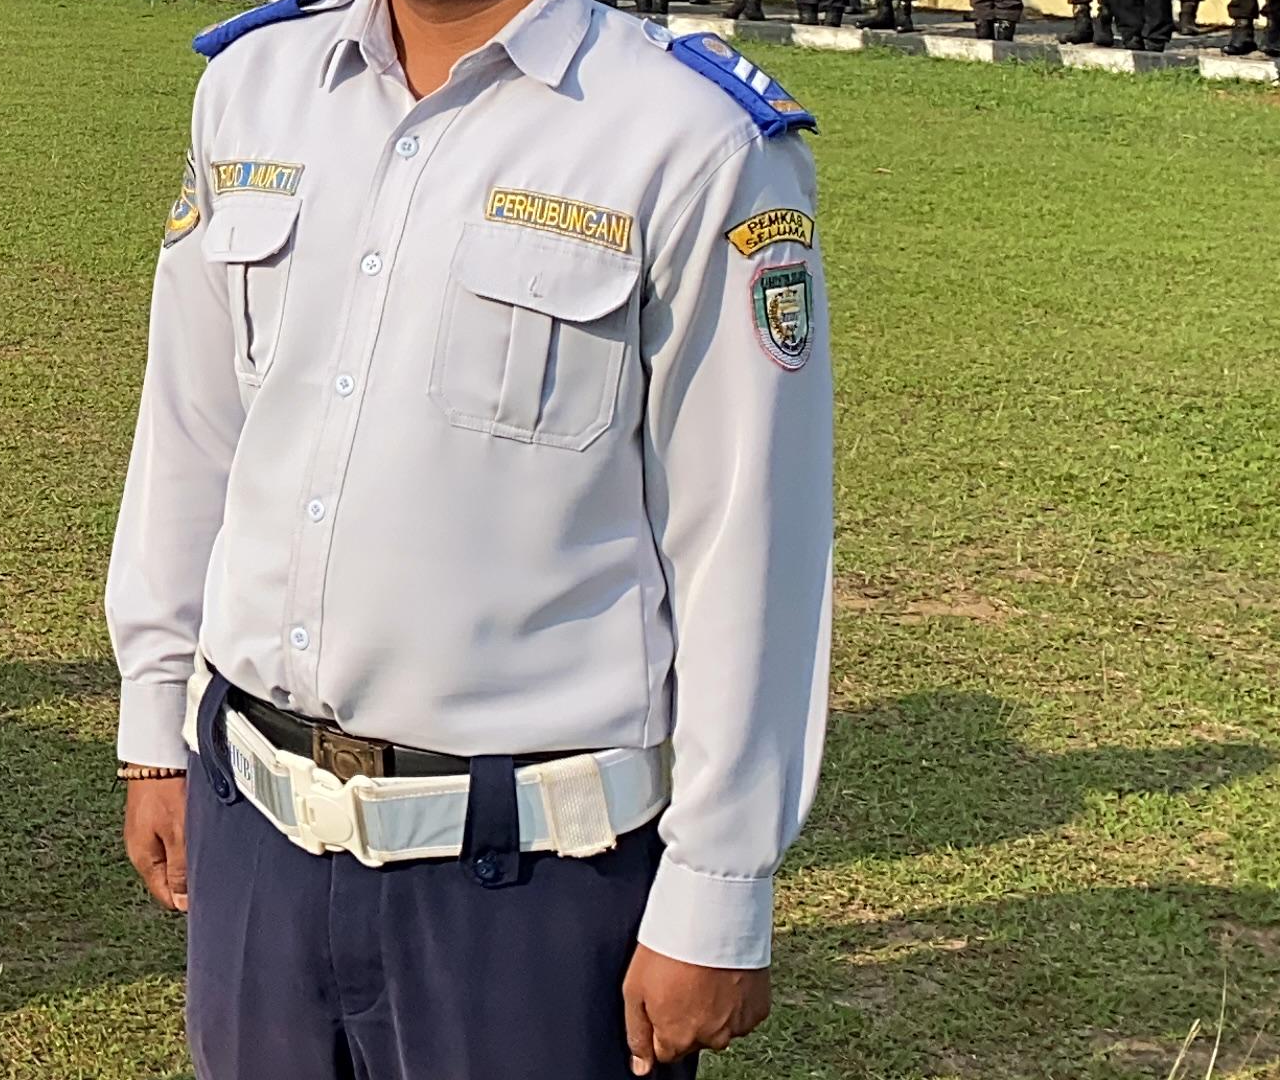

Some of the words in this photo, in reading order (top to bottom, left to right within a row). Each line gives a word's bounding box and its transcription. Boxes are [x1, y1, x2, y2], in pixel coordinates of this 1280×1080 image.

[246, 163, 296, 190] MUKTI
[492, 192, 625, 245] PERHUBUNGAN
[746, 211, 804, 235] PEMKAB
[745, 225, 808, 249] SELUMA
